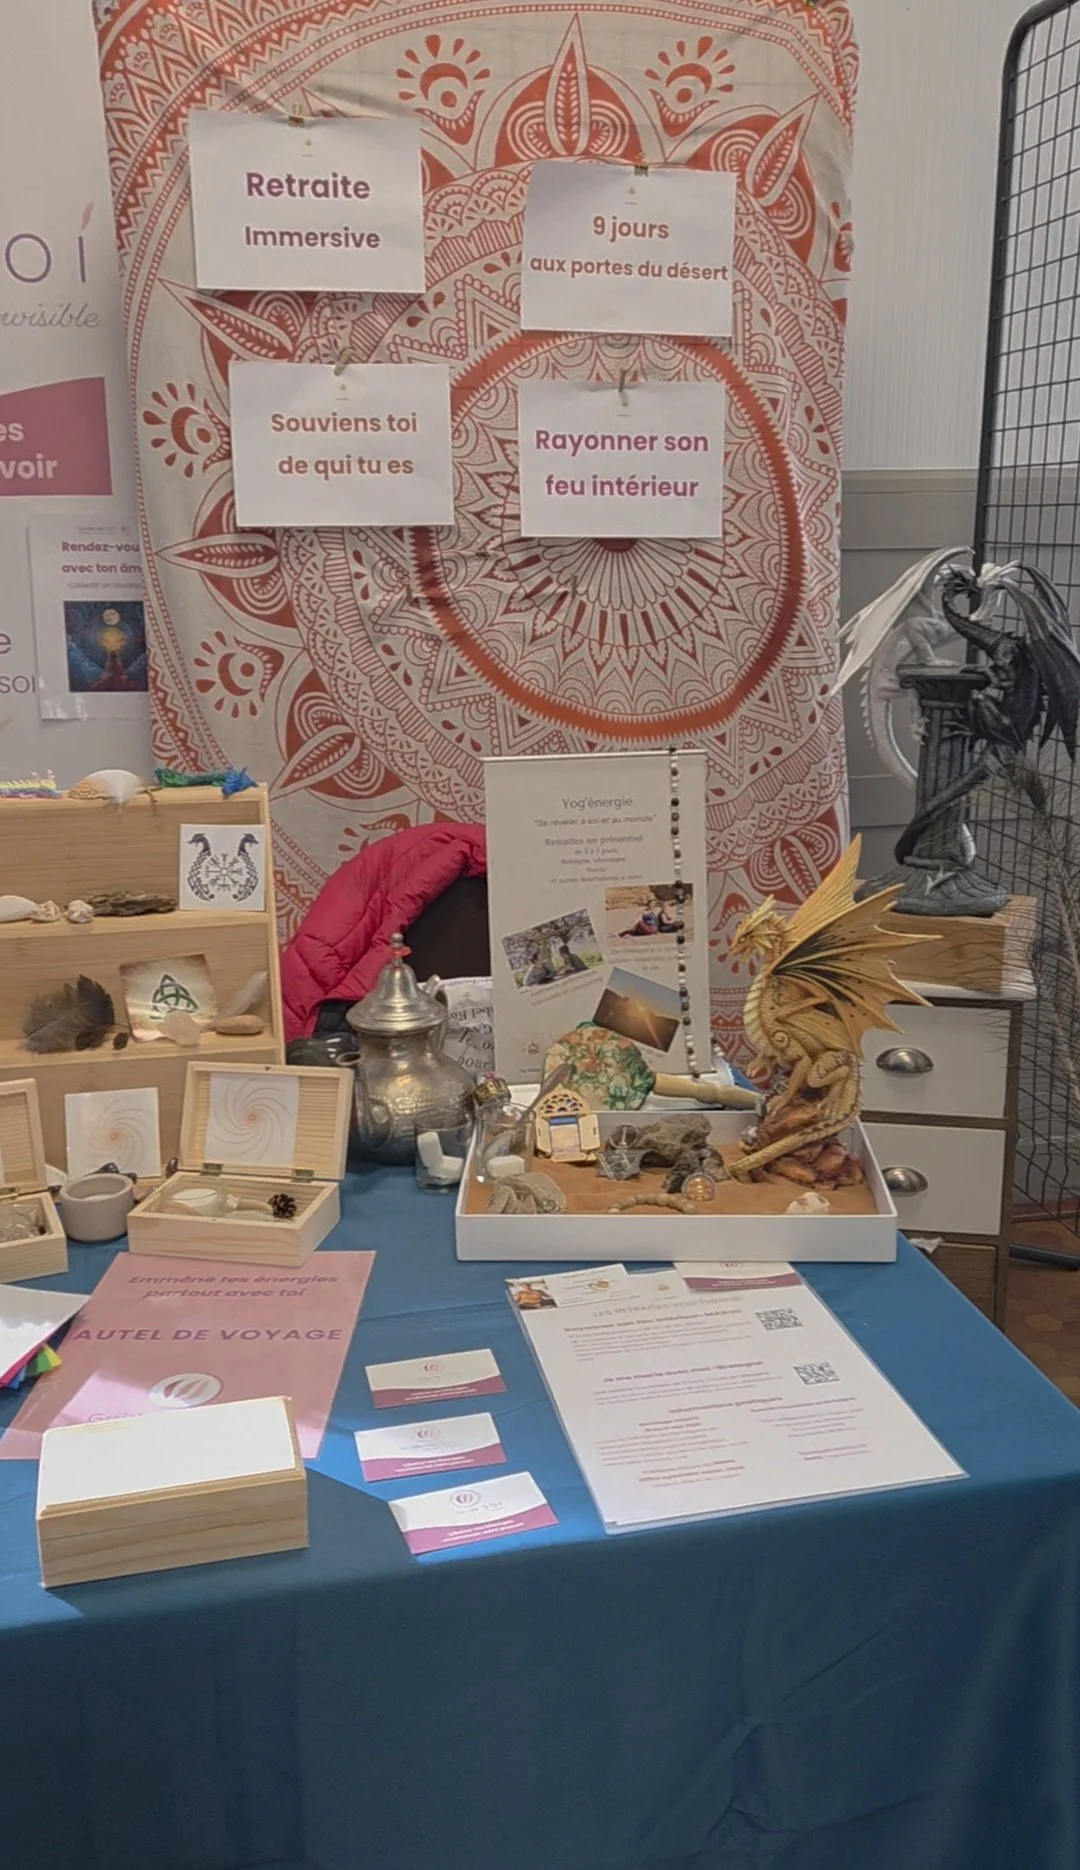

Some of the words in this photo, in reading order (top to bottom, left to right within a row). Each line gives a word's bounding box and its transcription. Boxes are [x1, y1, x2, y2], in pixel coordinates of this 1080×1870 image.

[246, 171, 371, 199] Retraite
[245, 226, 381, 248] Immersive
[593, 215, 606, 235] 9
[609, 215, 670, 243] jours
[530, 257, 567, 272] aux
[571, 259, 633, 278] portes
[637, 260, 662, 278] du
[667, 261, 729, 281] désert
[271, 411, 381, 433] Souviens
[387, 412, 418, 433] toi
[535, 430, 658, 457] Rayonner
[664, 434, 709, 452] son
[278, 456, 309, 475] de
[314, 454, 352, 481] qui
[357, 456, 382, 475] tu
[387, 459, 414, 475] es
[545, 474, 585, 497] feu
[592, 475, 699, 497] intérieur
[61, 563, 94, 573] avec
[96, 563, 118, 573] ton
[220, 1276, 248, 1284] tes
[253, 1274, 338, 1286] énergies
[143, 1287, 222, 1300] partout
[225, 1289, 275, 1298] avec
[279, 1288, 308, 1297] toi
[74, 1329, 163, 1341] AUTEL
[172, 1329, 211, 1341] DE
[220, 1329, 344, 1341] VOYAGE
